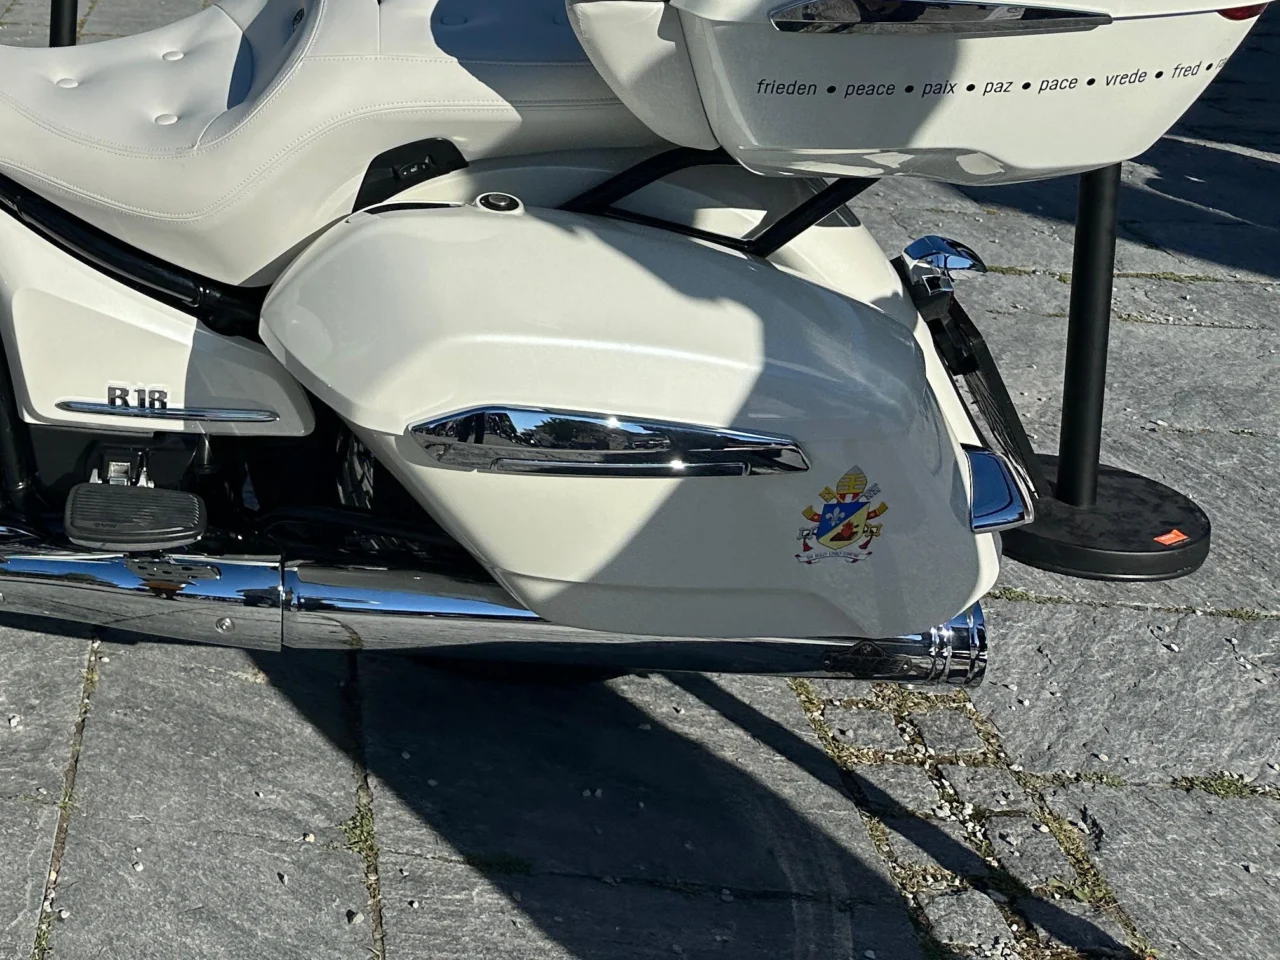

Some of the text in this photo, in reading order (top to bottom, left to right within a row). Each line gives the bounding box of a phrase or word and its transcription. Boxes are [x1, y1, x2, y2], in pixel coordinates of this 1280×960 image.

[756, 79, 817, 96] frieden
[844, 82, 896, 99] peace
[921, 80, 958, 98] paix
[983, 79, 1013, 96] paz
[1038, 76, 1078, 94] pace
[1105, 68, 1148, 86] vrede
[1172, 60, 1202, 78] fred
[107, 385, 168, 410] R18
